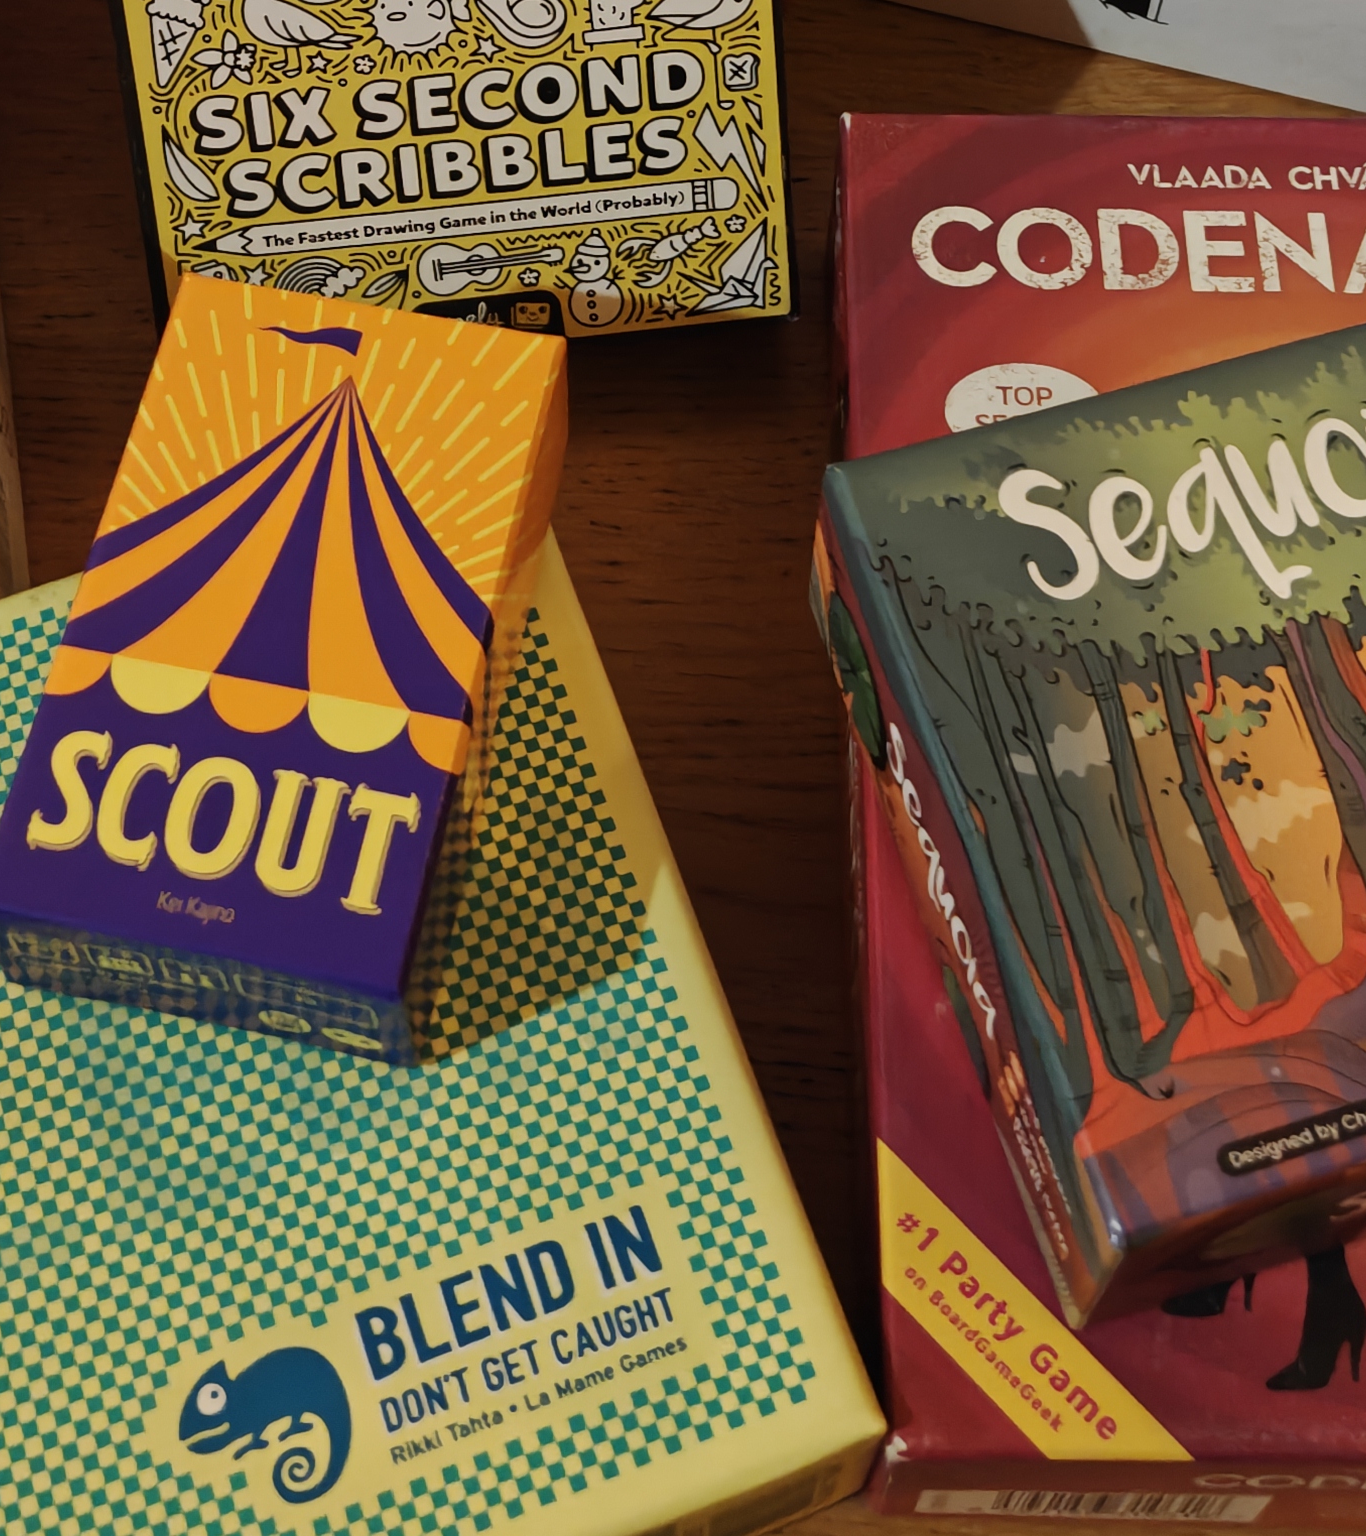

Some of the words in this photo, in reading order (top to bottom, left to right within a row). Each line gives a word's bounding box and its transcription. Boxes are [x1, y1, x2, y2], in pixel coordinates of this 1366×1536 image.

[194, 87, 337, 156] SIX
[357, 51, 705, 140] SECOND
[226, 116, 688, 218] SCRIBBLES
[263, 233, 296, 249] The
[298, 227, 360, 245] Fastest
[363, 220, 436, 240] Drawing
[439, 213, 487, 231] Game
[490, 210, 506, 224] in
[510, 206, 537, 222] the
[540, 200, 592, 219] World
[594, 190, 685, 215] (Probably)
[1126, 163, 1273, 191] VLAADA
[996, 385, 1053, 407] TOP
[26, 730, 422, 916] SCOUT
[1229, 1126, 1314, 1169] Designed
[1315, 1117, 1340, 1142] by
[355, 1239, 577, 1382] BLEND
[584, 1205, 663, 1292] IN
[897, 1211, 939, 1252] #1
[939, 1250, 1025, 1341] Party
[1029, 1343, 1118, 1440] Game
[904, 1266, 928, 1291] on
[929, 1290, 1064, 1433] BoardGameGeek
[380, 1367, 471, 1434] DON'T
[481, 1340, 543, 1393] GET
[551, 1288, 678, 1367] CAUGHT
[390, 1428, 442, 1465] Rikki
[444, 1411, 504, 1443] Tahta
[525, 1391, 549, 1413] La
[554, 1365, 615, 1403] Mame
[619, 1335, 689, 1376] Games
